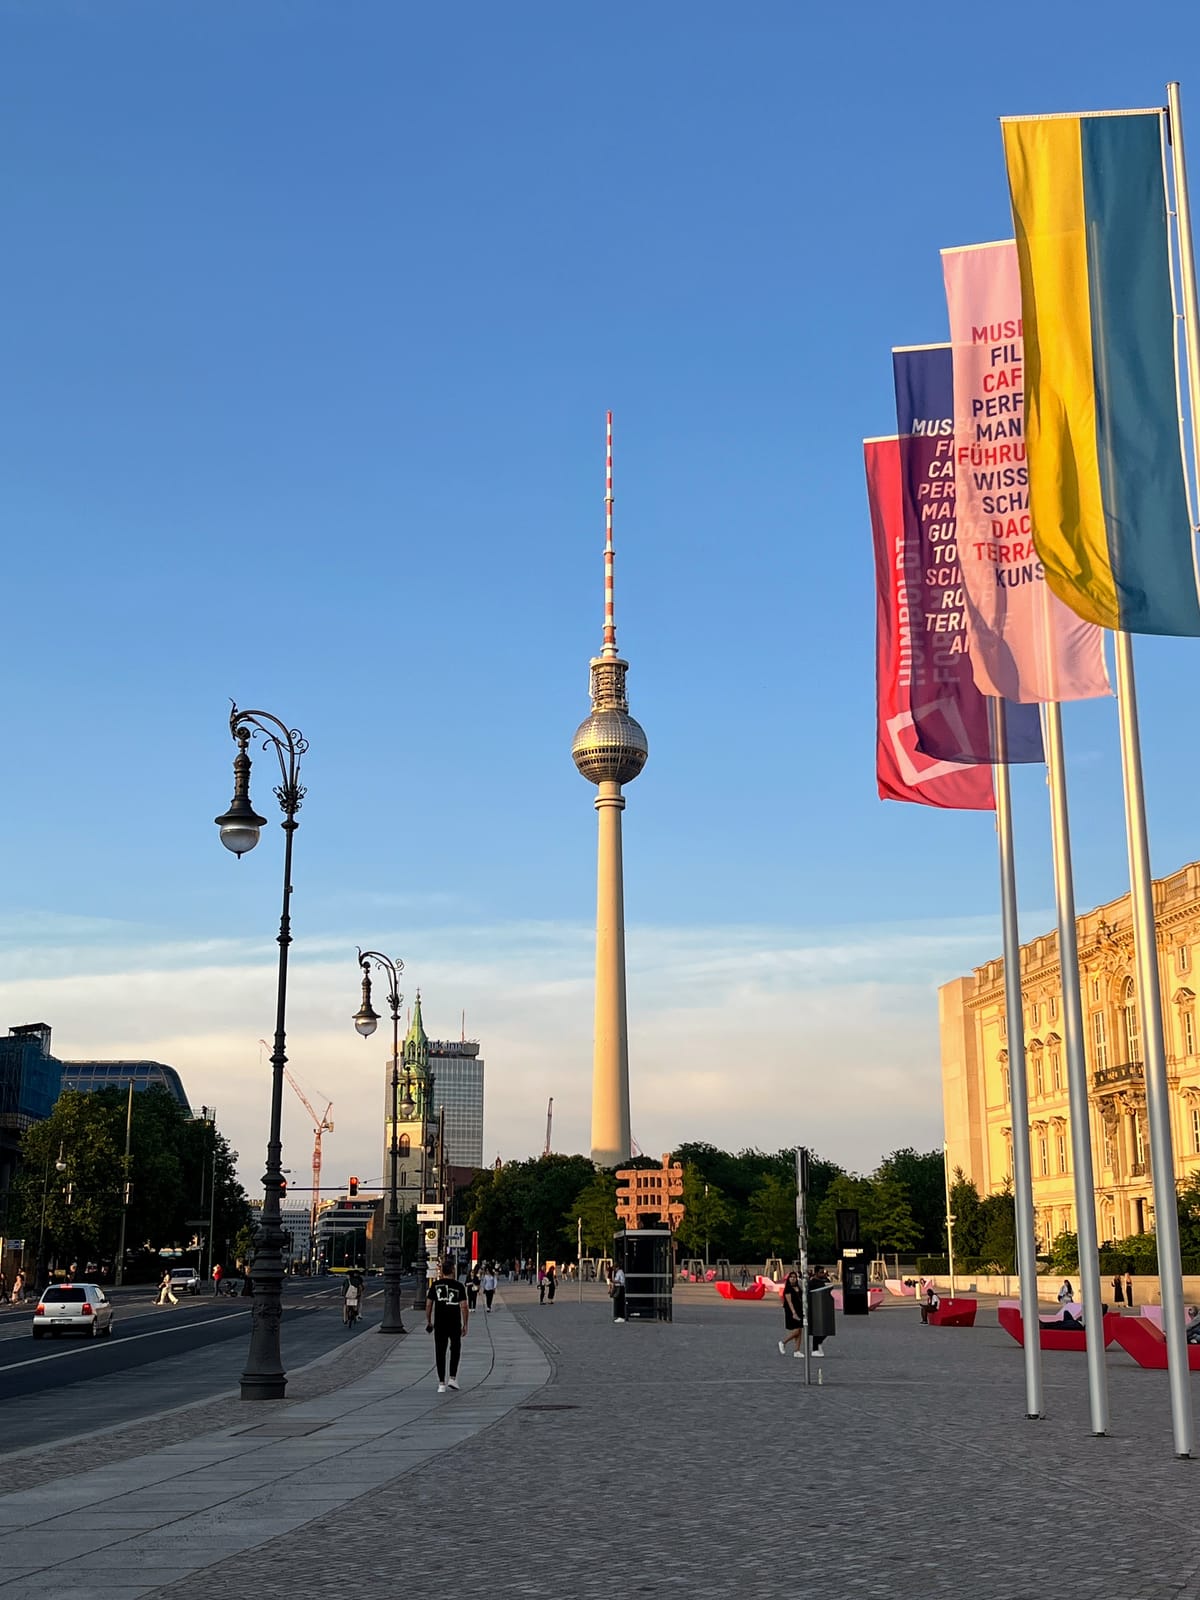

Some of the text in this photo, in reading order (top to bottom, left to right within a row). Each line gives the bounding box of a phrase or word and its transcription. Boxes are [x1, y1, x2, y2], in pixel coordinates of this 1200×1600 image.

[991, 344, 1022, 367] FIL
[983, 368, 1022, 393] CAF
[972, 393, 1023, 417] PERF
[912, 418, 954, 437] MUS
[976, 418, 1021, 442] MAN
[958, 442, 1026, 467] FÜHRU
[974, 467, 1028, 491] WISS
[921, 502, 956, 522] MA
[928, 522, 957, 542] GU
[992, 515, 1031, 539] DAC
[933, 544, 957, 564] TO
[995, 563, 1045, 588] KUNS
